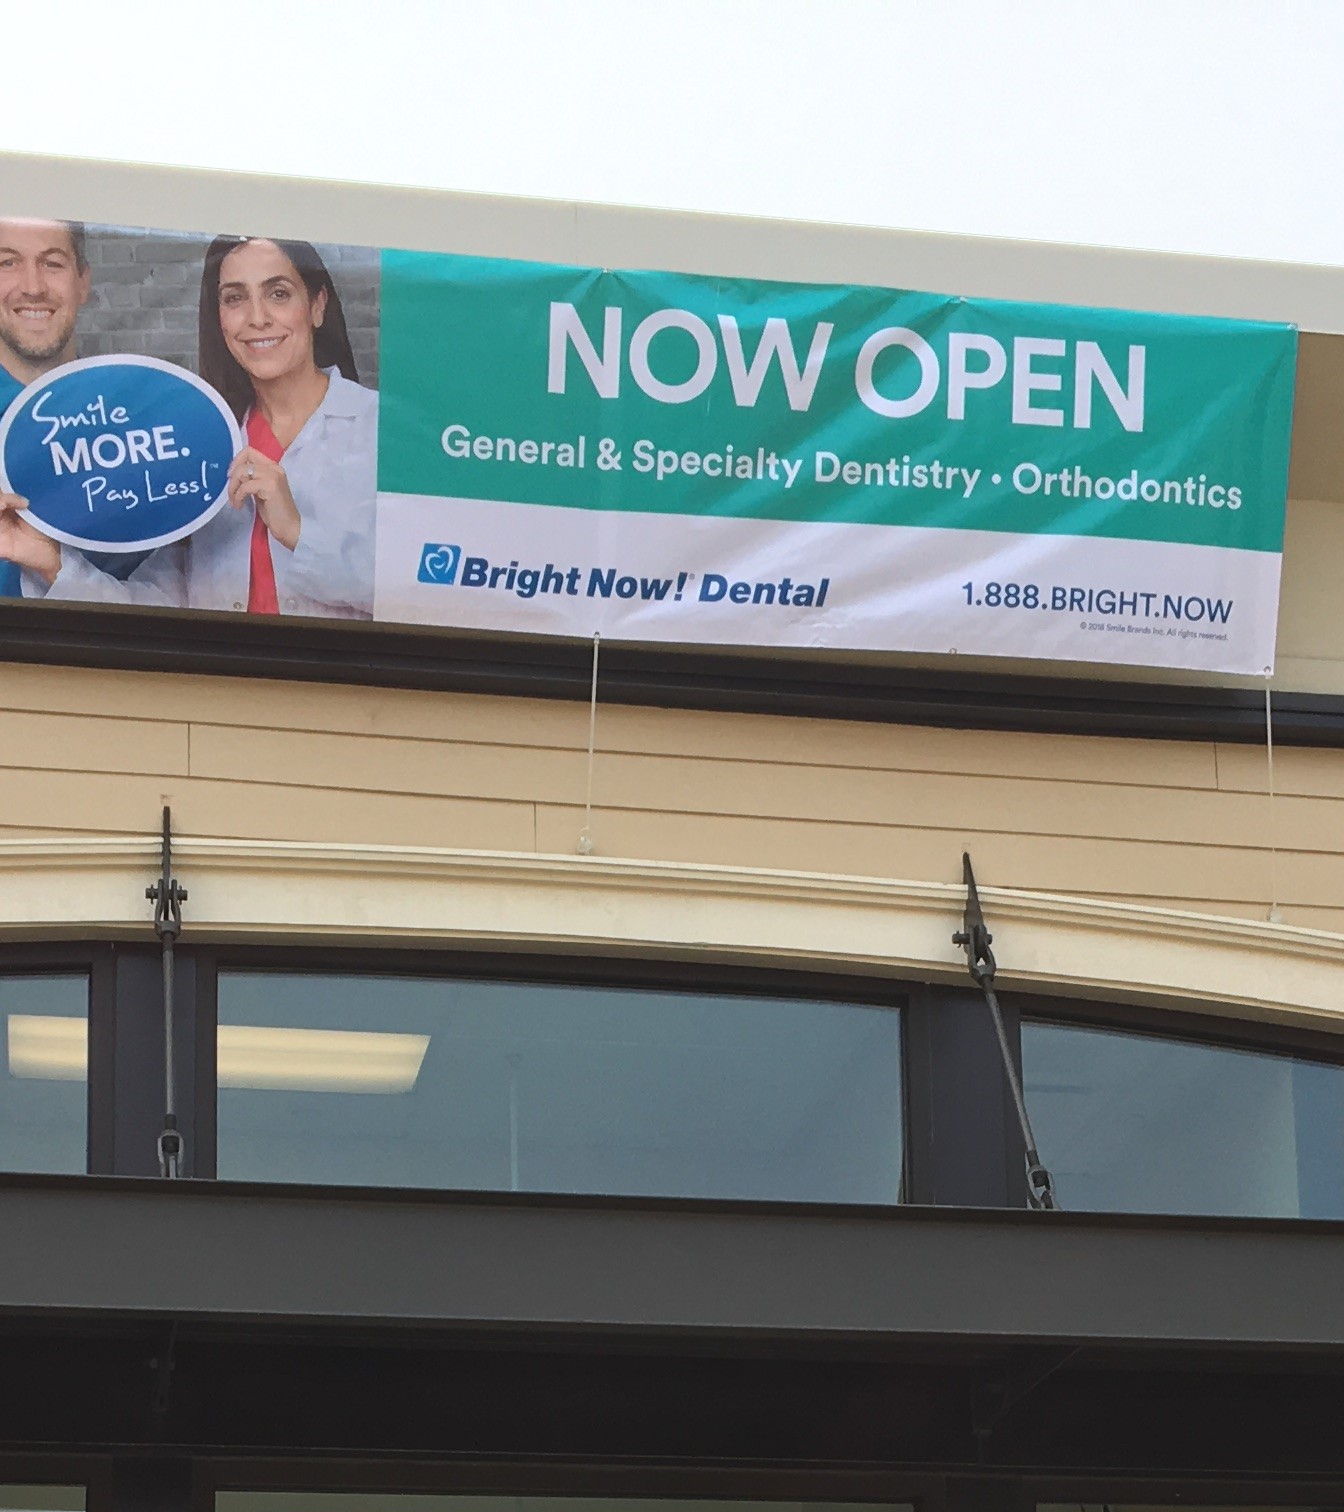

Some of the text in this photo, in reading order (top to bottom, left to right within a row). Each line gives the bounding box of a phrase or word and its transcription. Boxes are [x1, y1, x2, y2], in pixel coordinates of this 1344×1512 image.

[548, 301, 1147, 433] NOW OPEN
[32, 391, 130, 445] Smile
[49, 425, 190, 476] MORE.
[441, 424, 1243, 510] General & Specialty Dentistry Orthodontics
[82, 460, 213, 512] Pay Less!
[460, 557, 830, 608] Bright Now! Dental
[961, 581, 1234, 625] 1.888.BRIGHT.NOW
[1106, 623, 1125, 633] Smile
[1127, 625, 1151, 634] Brands
[1166, 628, 1176, 636] All
[1178, 628, 1197, 639] rights
